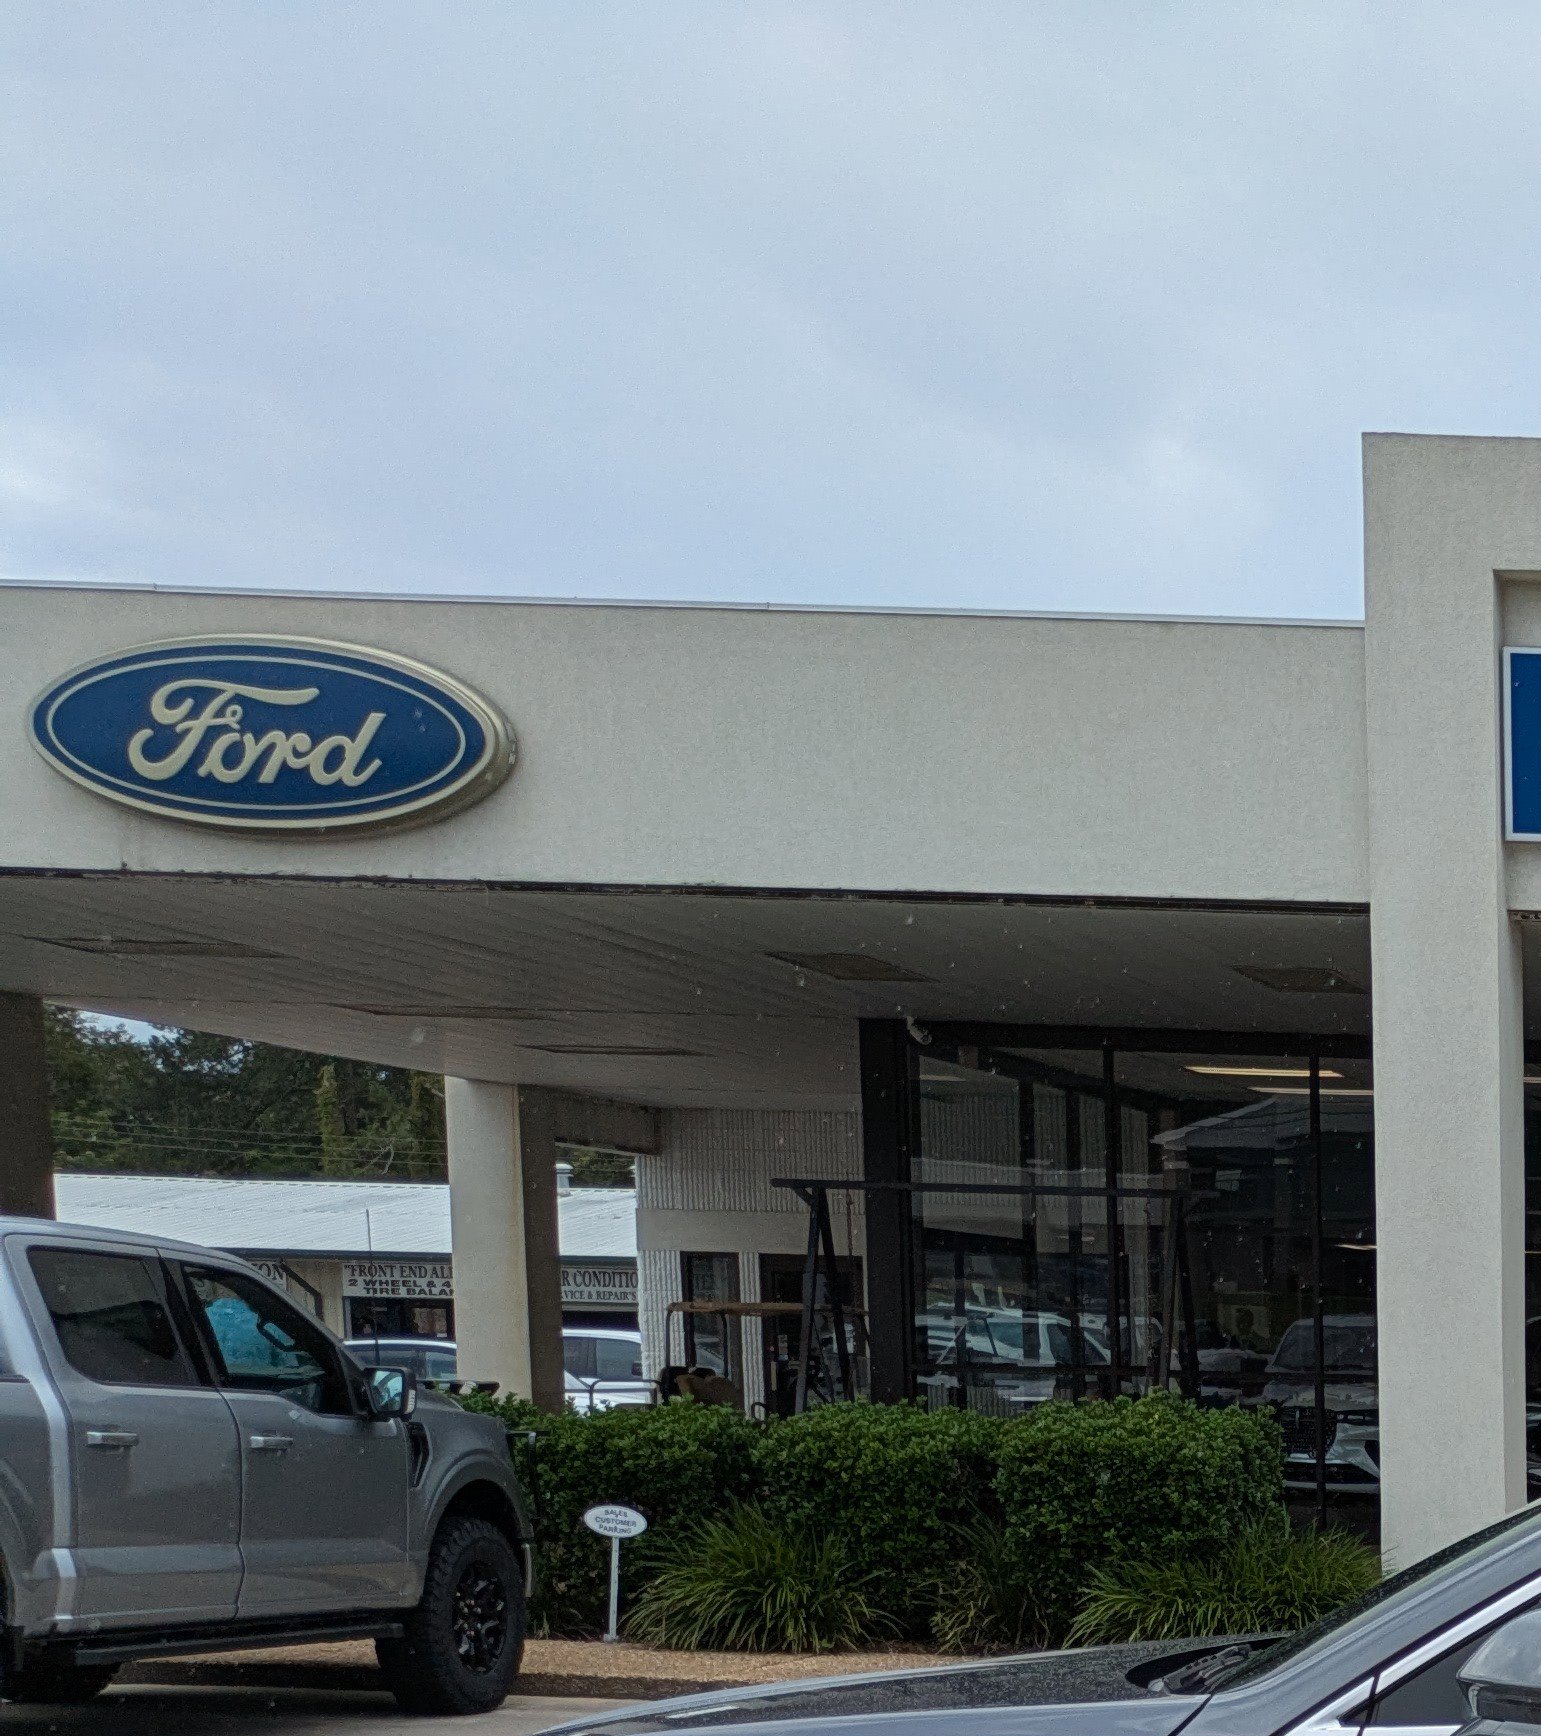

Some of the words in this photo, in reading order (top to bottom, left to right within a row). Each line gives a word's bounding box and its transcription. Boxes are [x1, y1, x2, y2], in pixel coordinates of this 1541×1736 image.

[128, 679, 386, 788] Ford
[400, 1265, 427, 1279] END
[348, 1279, 358, 1287] 2
[363, 1279, 422, 1288] WHEEL
[427, 1280, 436, 1288] &
[363, 1287, 401, 1296] TIRE
[604, 1509, 629, 1518] SALES
[595, 1516, 637, 1528] CUSTOMER
[599, 1523, 632, 1535] PARKING
